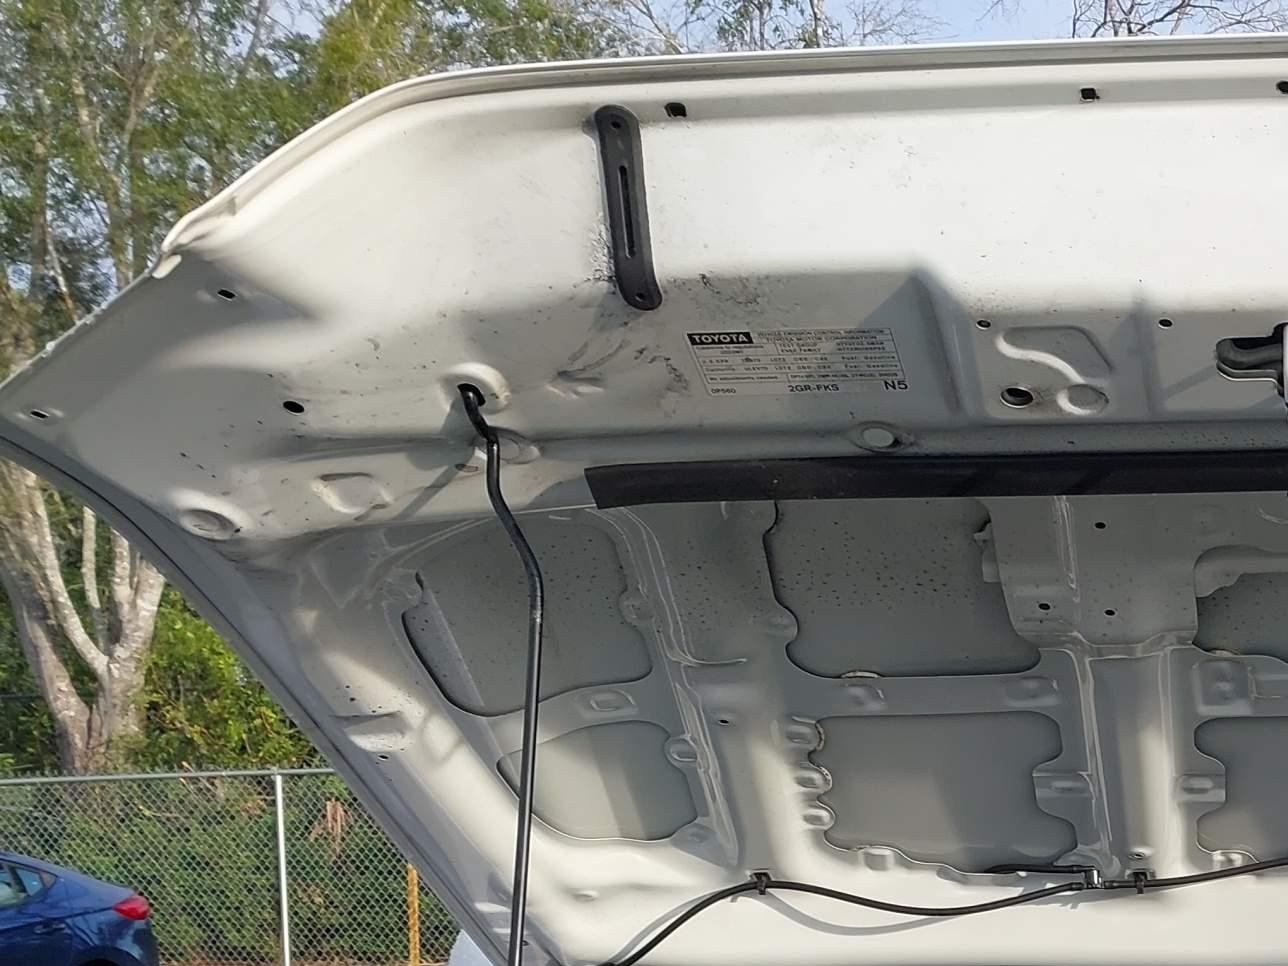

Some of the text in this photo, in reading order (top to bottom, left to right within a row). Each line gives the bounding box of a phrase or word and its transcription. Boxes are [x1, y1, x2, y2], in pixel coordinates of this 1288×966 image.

[691, 333, 749, 343] TOYOTA
[787, 383, 840, 393] 2GR-FKS
[883, 379, 909, 391] N5
